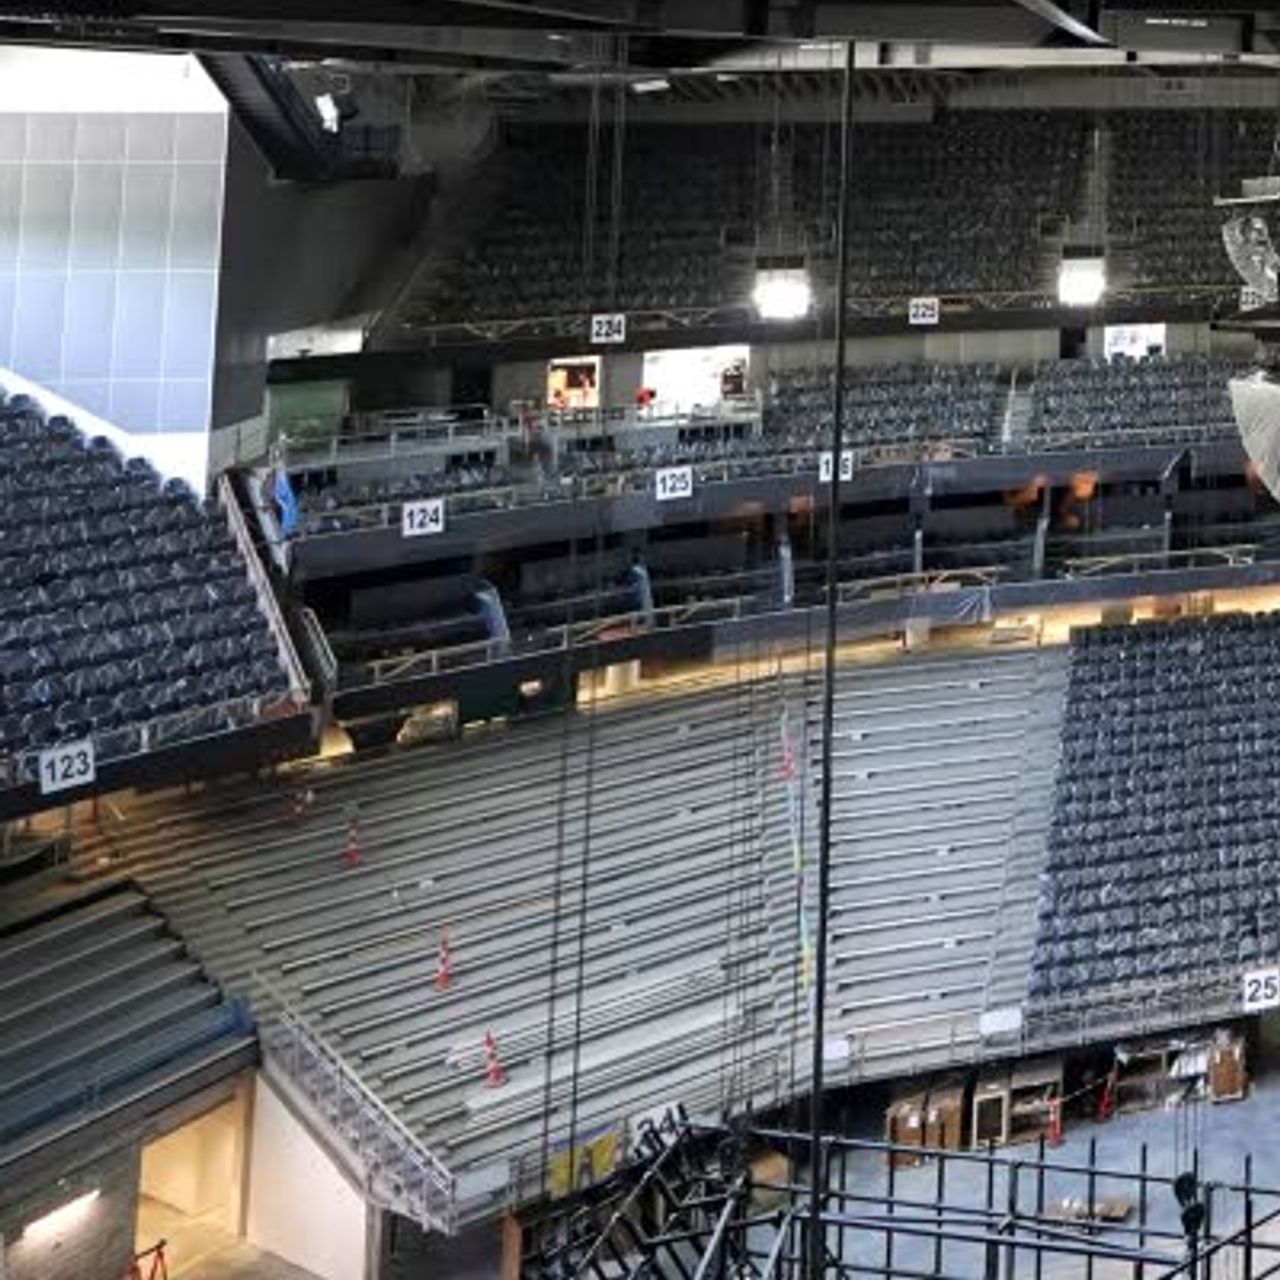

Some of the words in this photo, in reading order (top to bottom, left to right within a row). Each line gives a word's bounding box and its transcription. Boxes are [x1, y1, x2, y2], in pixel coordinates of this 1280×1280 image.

[658, 472, 690, 496] 125
[406, 505, 441, 530] 124
[43, 750, 92, 784] 123
[1247, 975, 1279, 1003] 25
